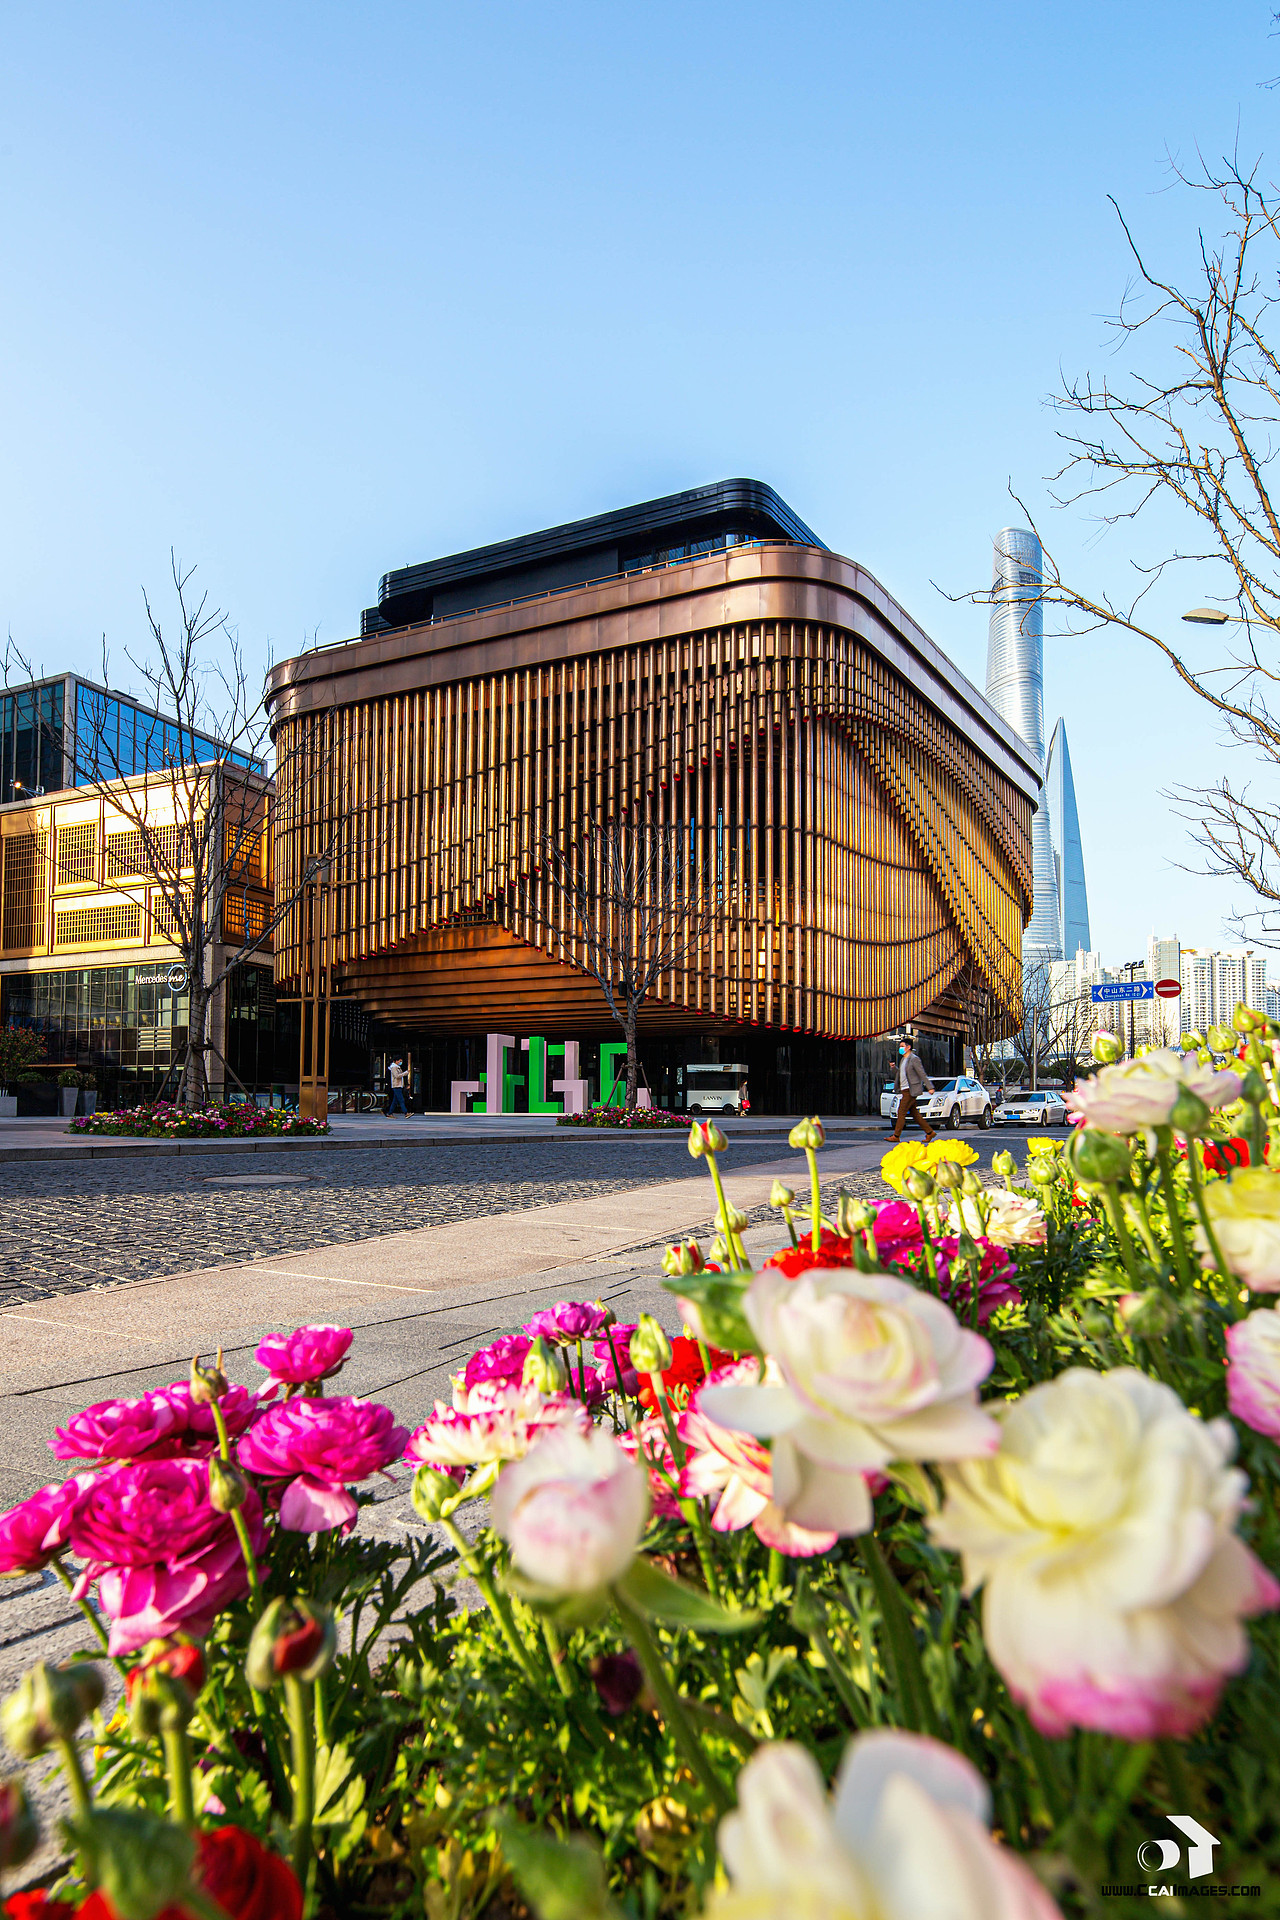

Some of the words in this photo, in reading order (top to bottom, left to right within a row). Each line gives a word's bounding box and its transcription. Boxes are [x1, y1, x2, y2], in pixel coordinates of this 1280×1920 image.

[135, 974, 167, 985] Mercedes
[168, 974, 185, 983] me
[1104, 986, 1140, 994] 中山东二路
